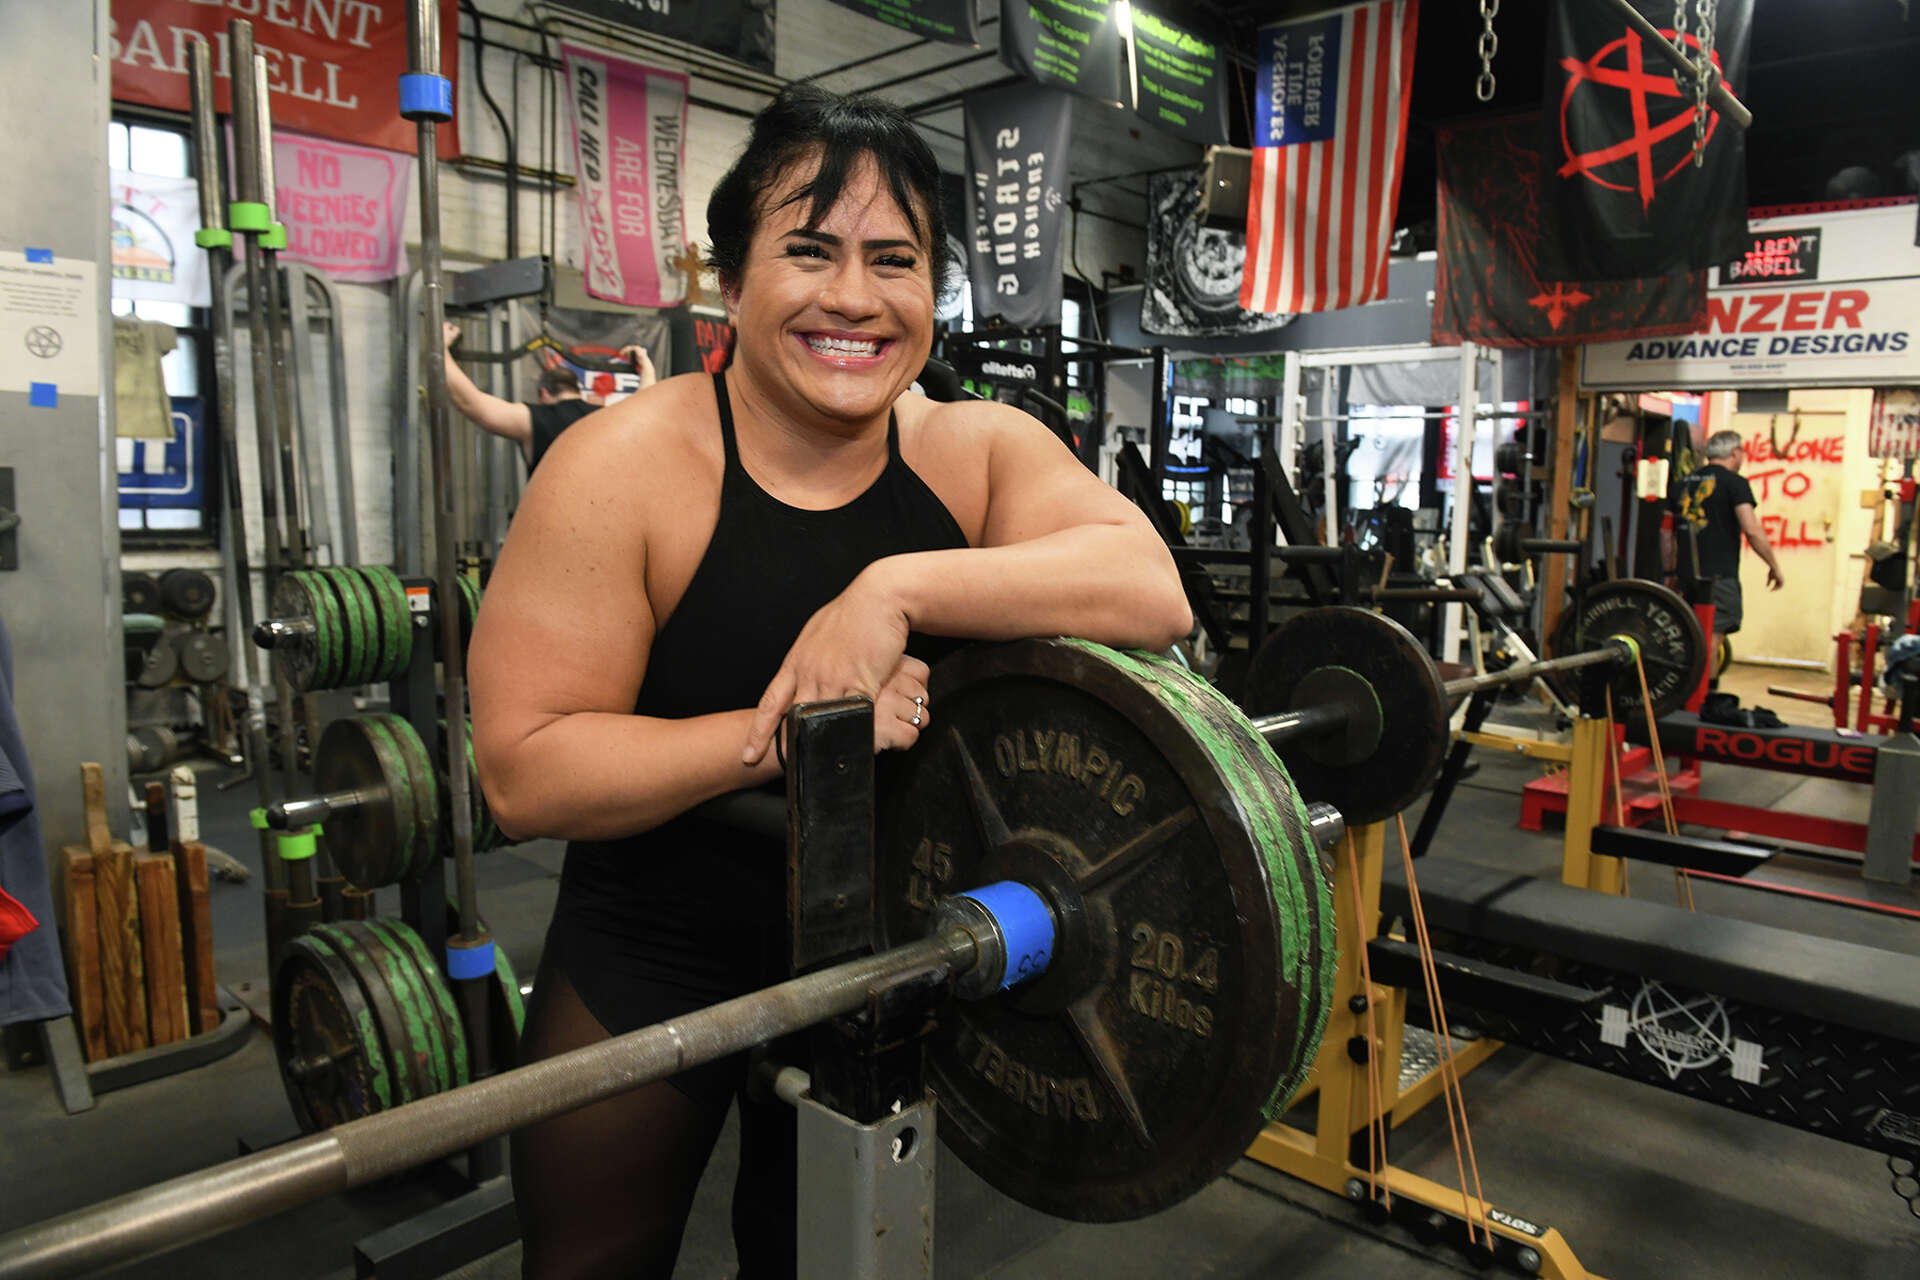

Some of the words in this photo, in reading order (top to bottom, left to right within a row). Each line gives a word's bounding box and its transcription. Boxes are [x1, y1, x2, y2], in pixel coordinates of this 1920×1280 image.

[190, 0, 382, 48] BENT
[577, 65, 600, 126] CALL
[297, 150, 341, 189] NO
[615, 136, 643, 188] ARE
[616, 188, 647, 239] FOR
[1692, 289, 1871, 335] NZER
[1626, 337, 1760, 362] ADVANCE
[1767, 331, 1909, 357] DESIGNS
[1746, 468, 1811, 502] TO
[1742, 515, 1823, 549] ELL
[1647, 602, 1686, 656] YORK
[994, 729, 1146, 817] OLYMPIC
[1696, 727, 1873, 774] ROGUE
[911, 837, 952, 881] 45
[1130, 921, 1218, 993] 20.4
